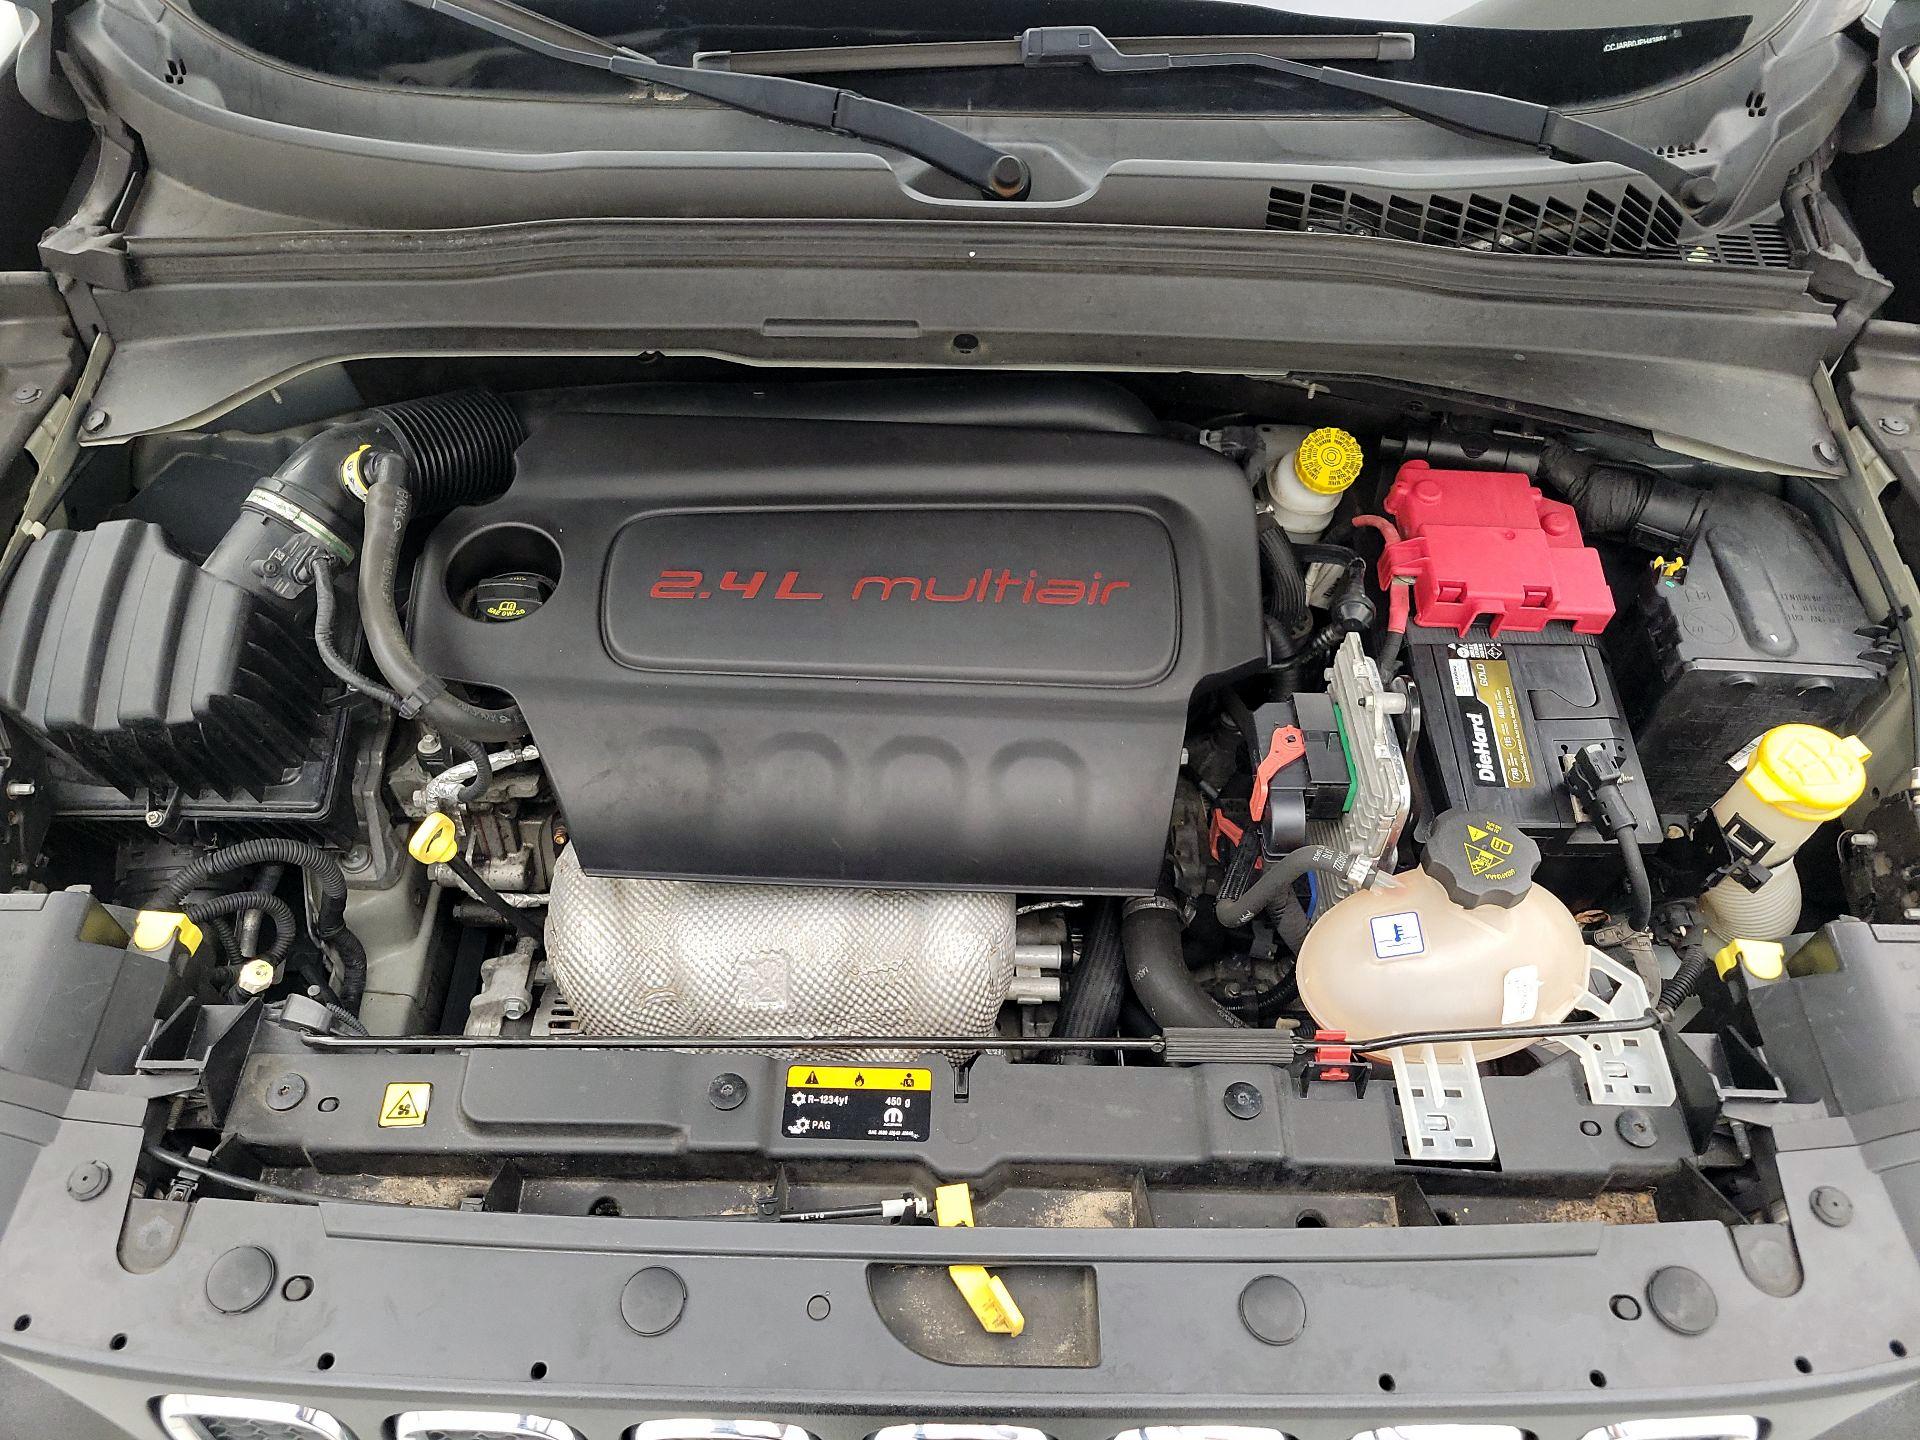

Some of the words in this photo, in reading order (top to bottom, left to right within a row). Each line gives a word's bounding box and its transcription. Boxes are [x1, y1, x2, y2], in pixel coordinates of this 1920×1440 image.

[852, 568, 1129, 605] multiair
[1476, 664, 1488, 687] GOLD
[1466, 712, 1496, 782] DieHard
[807, 1094, 849, 1106] R-1234yf
[885, 1096, 902, 1106] 450
[904, 1097, 911, 1108] g
[811, 1121, 831, 1130] PAG
